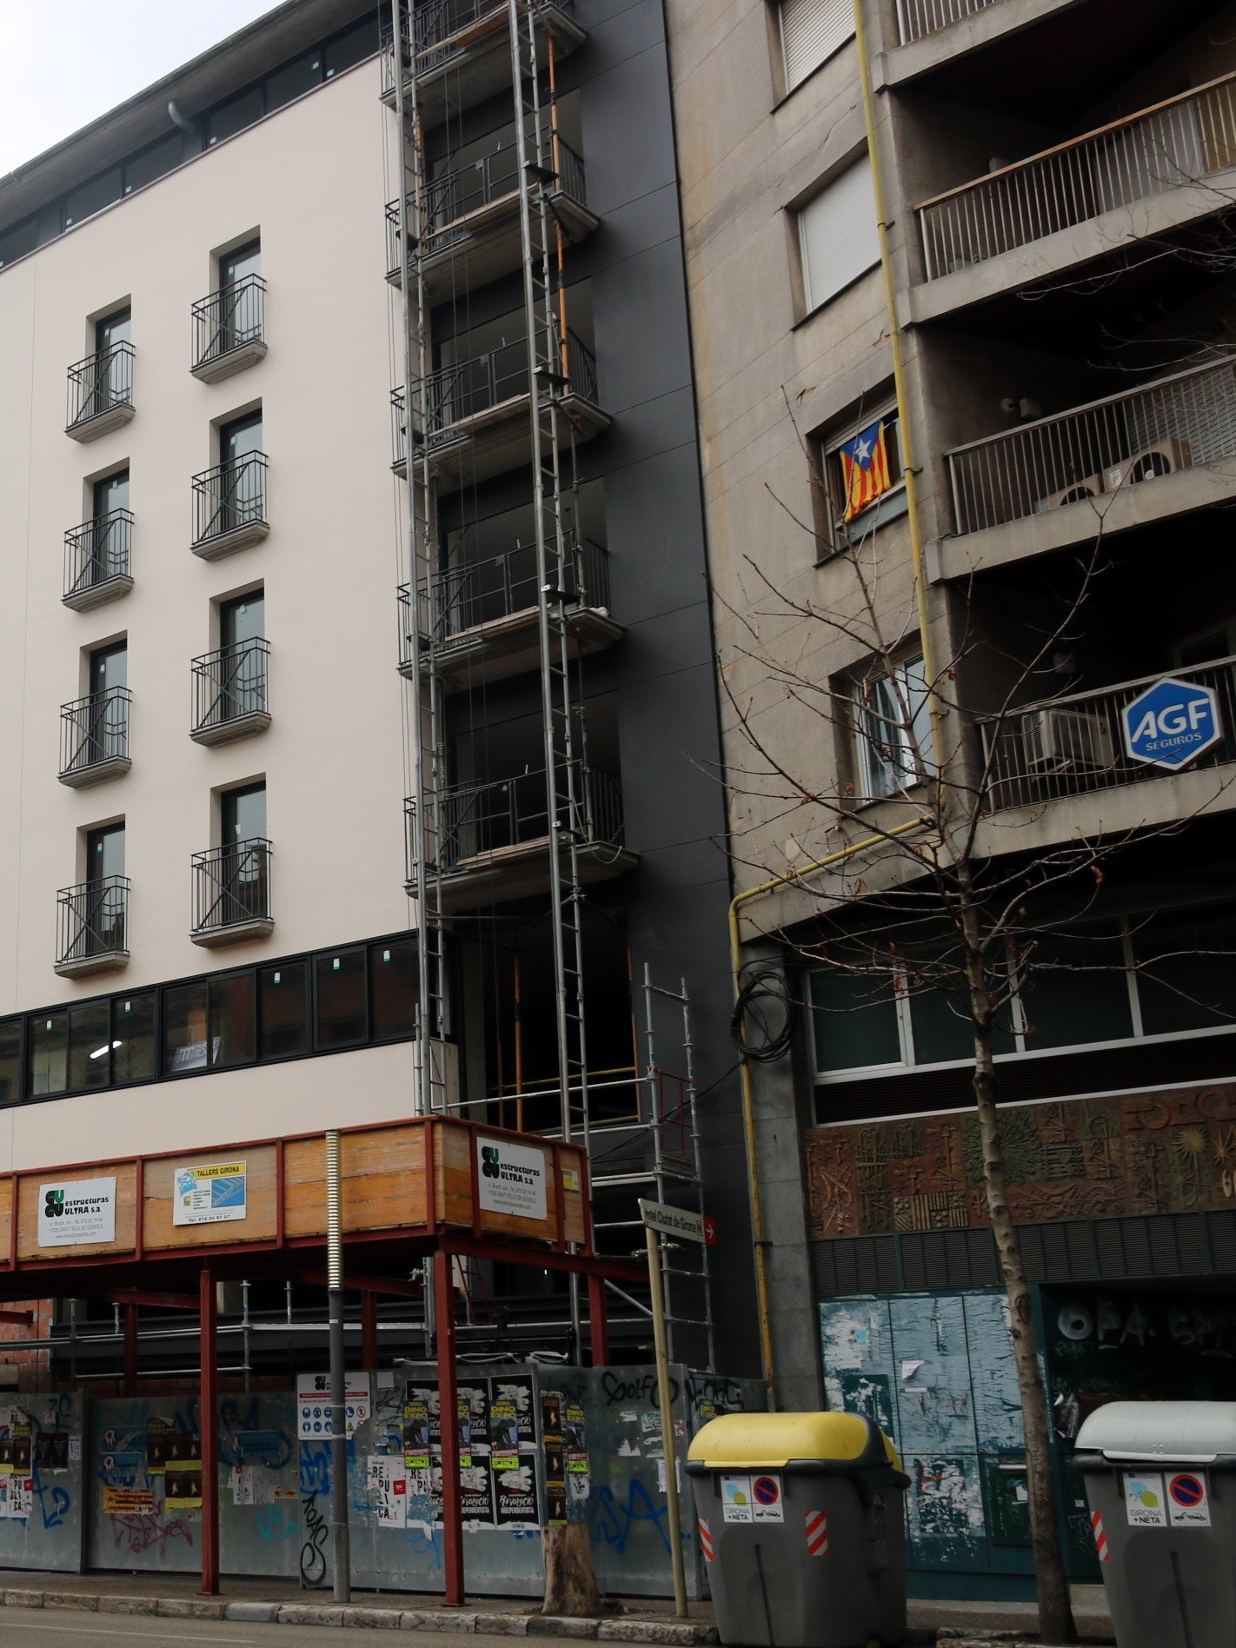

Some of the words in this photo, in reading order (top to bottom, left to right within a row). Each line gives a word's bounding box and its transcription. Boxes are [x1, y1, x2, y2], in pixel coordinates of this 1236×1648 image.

[1131, 698, 1210, 743] AGF
[1146, 732, 1202, 751] SEGUROS
[197, 1168, 219, 1176] TALLERS
[219, 1166, 240, 1174] GIRONA
[500, 1163, 540, 1177] estructuras
[500, 1171, 524, 1183] ULTRA
[65, 1197, 109, 1207] estructuras
[65, 1206, 90, 1215] ULTRA
[644, 1209, 657, 1222] Hotel
[657, 1211, 673, 1228] Ciutat
[673, 1216, 681, 1230] de
[680, 1217, 696, 1234] Girona
[1130, 1510, 1162, 1518] GIRONA
